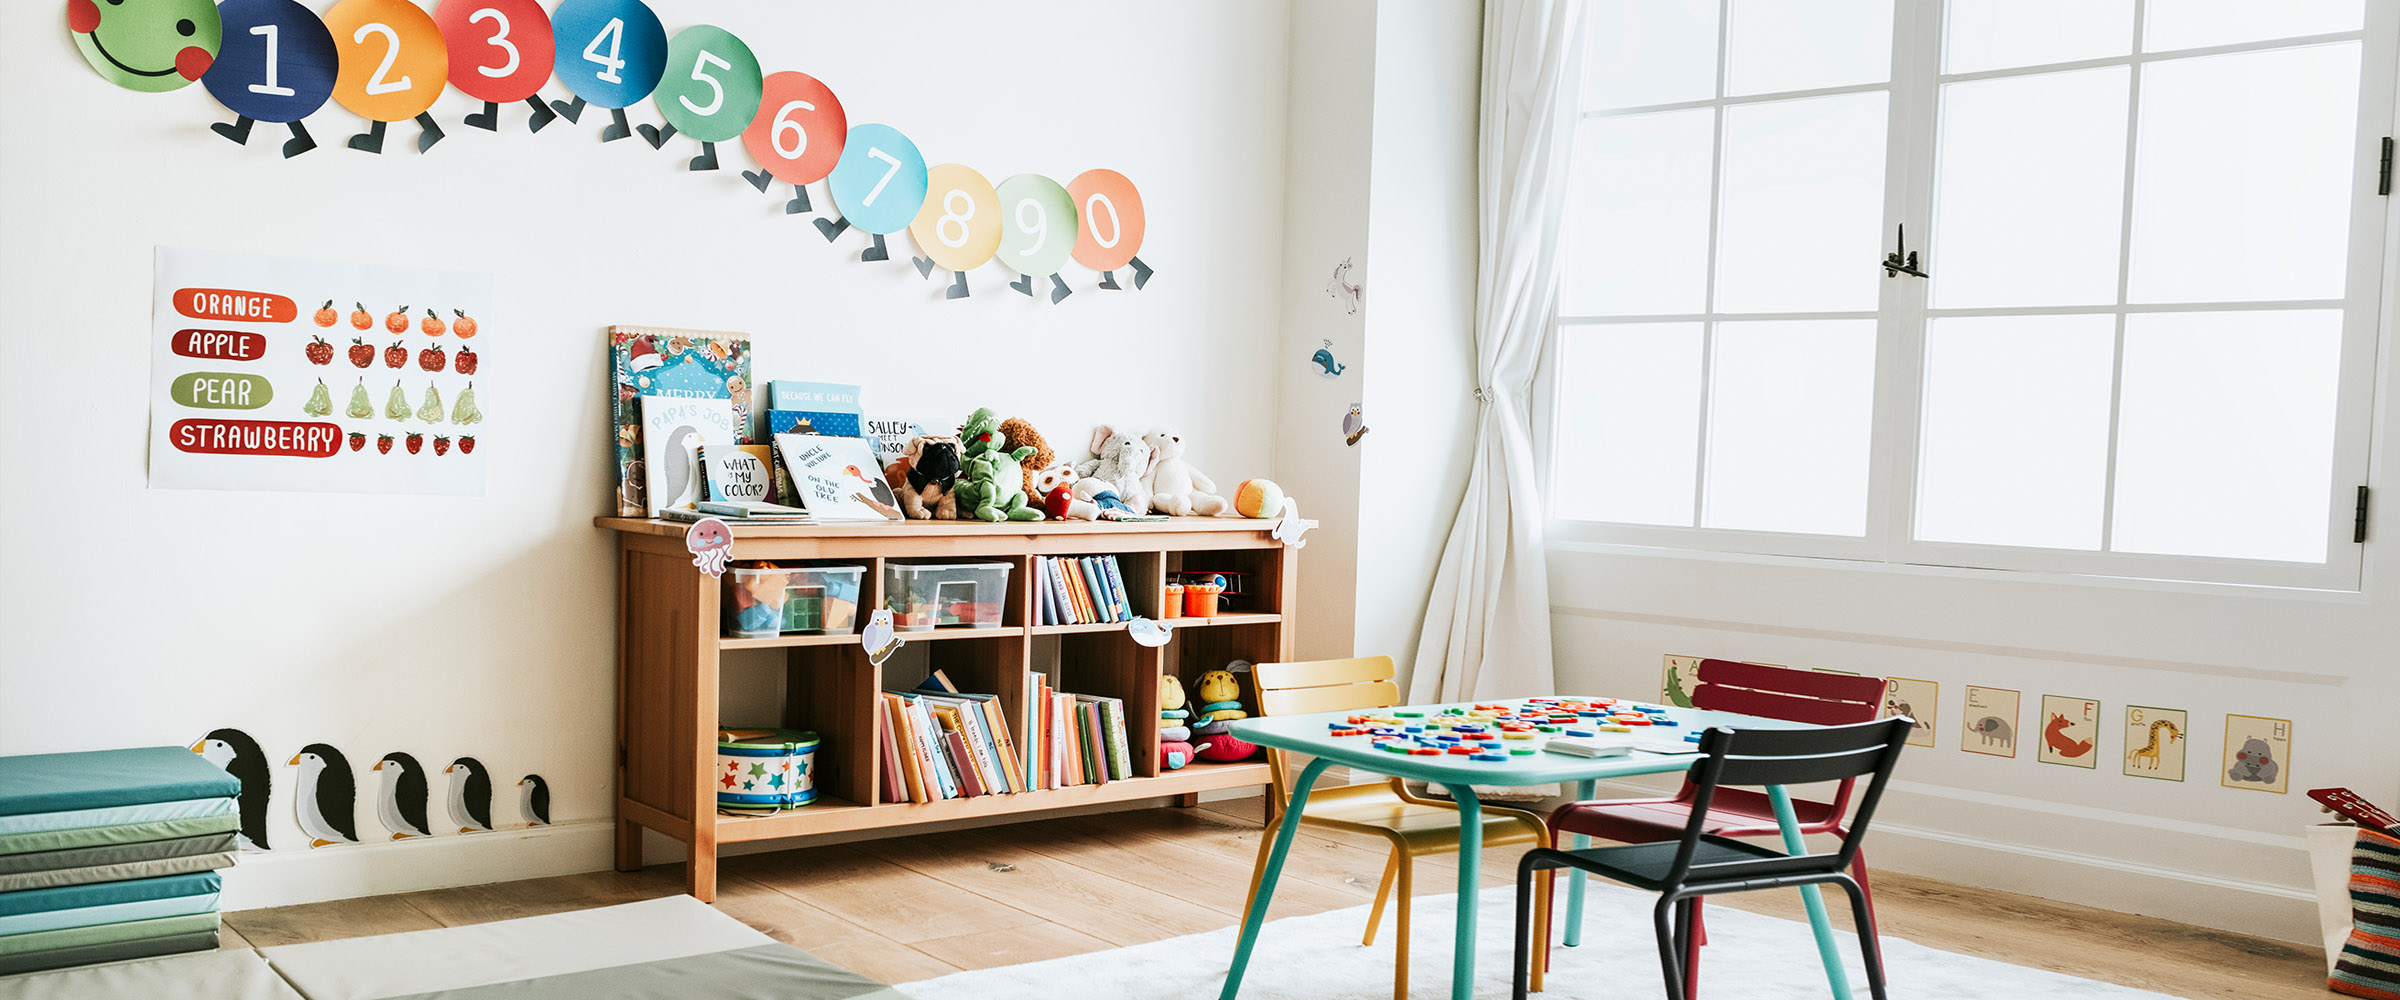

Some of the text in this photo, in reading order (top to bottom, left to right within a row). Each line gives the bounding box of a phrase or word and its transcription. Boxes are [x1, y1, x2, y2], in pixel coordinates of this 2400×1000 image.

[247, 8, 1121, 257] 1 2 3 4 5 6 7 8 9 0
[193, 292, 273, 319] ORANGE
[188, 332, 250, 358] APPLE
[193, 378, 252, 406] PEAR
[781, 391, 811, 401] BECAUSE
[814, 392, 825, 402] WE
[652, 404, 729, 431] PAPA'S JOB
[868, 420, 907, 435] SALLEY
[180, 424, 334, 453] STRAWBERRY
[799, 444, 824, 461] UNCLE
[805, 451, 832, 469] VULTURE
[723, 458, 757, 471] WHAT
[735, 471, 752, 484] MY
[807, 474, 840, 489] ON THE
[724, 483, 764, 497] COLOR?
[814, 490, 839, 503] TREE
[815, 484, 835, 495] OLD
[1689, 660, 1698, 672] A
[1889, 679, 1899, 693] D
[1969, 688, 1980, 703] E
[2084, 702, 2095, 716] F
[2130, 708, 2144, 723] G
[2273, 721, 2286, 737] H
